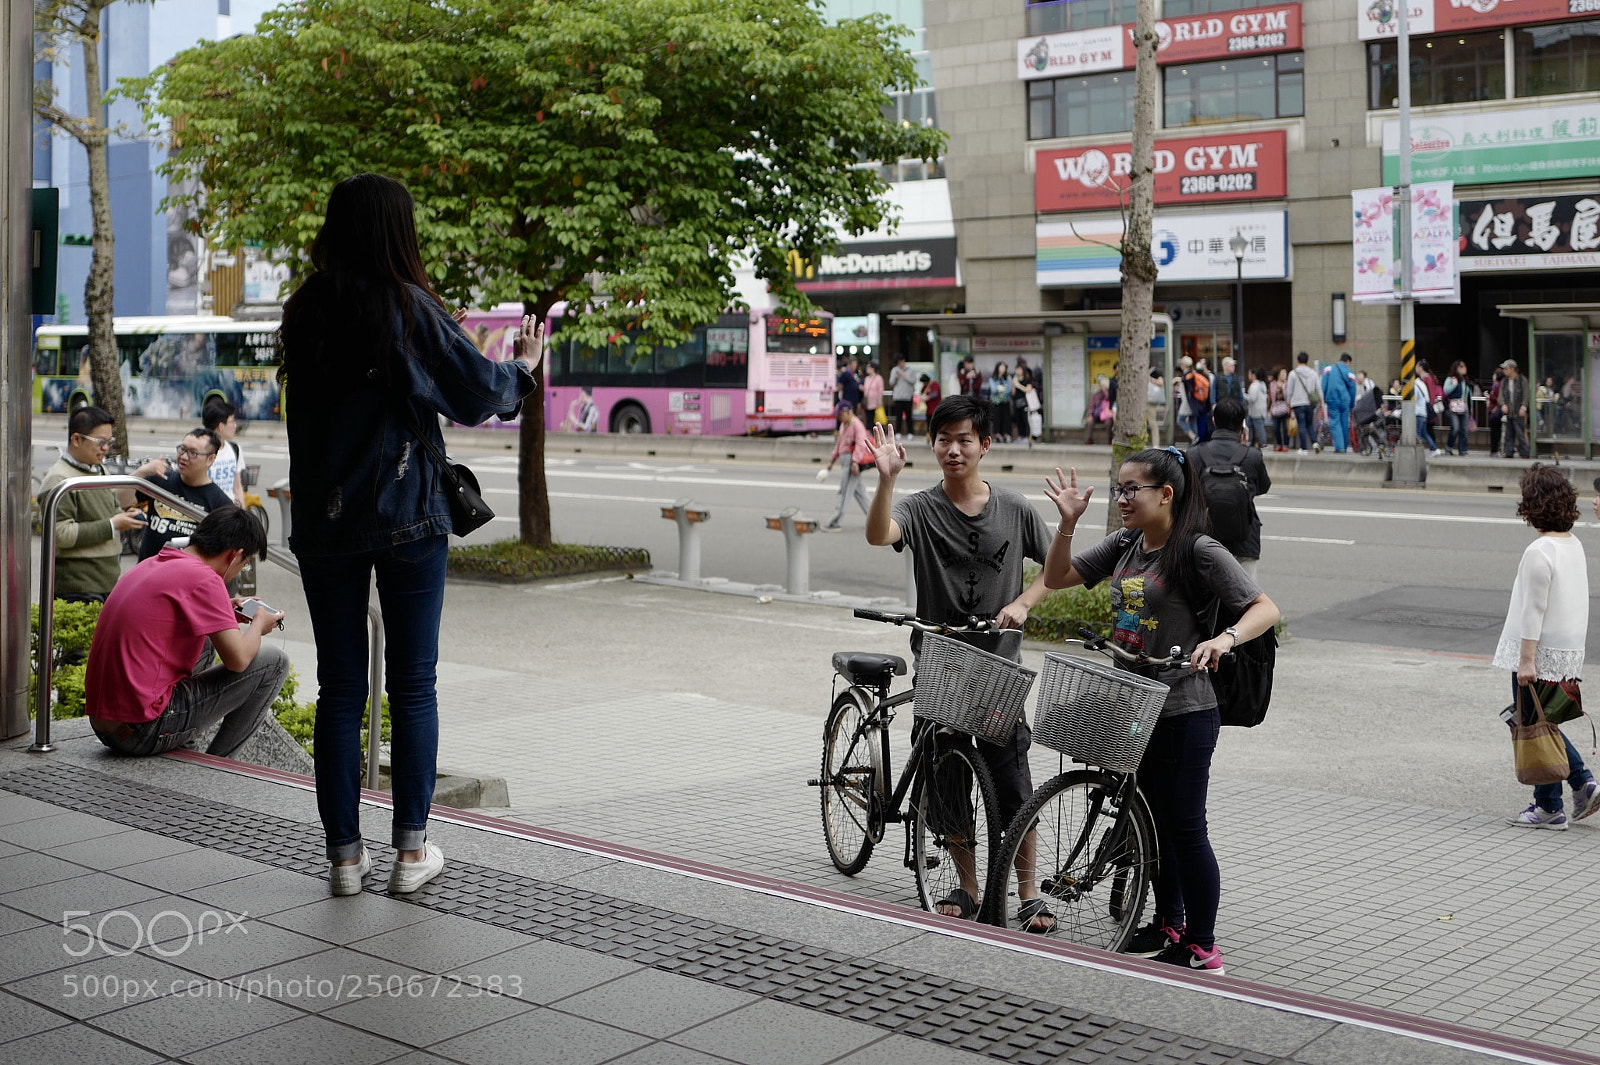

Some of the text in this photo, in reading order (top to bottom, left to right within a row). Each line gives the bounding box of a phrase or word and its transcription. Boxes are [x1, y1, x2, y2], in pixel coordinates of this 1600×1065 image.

[1230, 11, 1287, 34] GYM
[1024, 51, 1112, 71] WORLD GYM
[1054, 143, 1259, 188] WORD GYM
[1413, 229, 1451, 240] AZALEA
[1472, 199, 1600, 251] 但馬屋
[1188, 235, 1266, 254] 中華信
[1355, 234, 1391, 246] AZALEA
[818, 251, 931, 275] McDonald's
